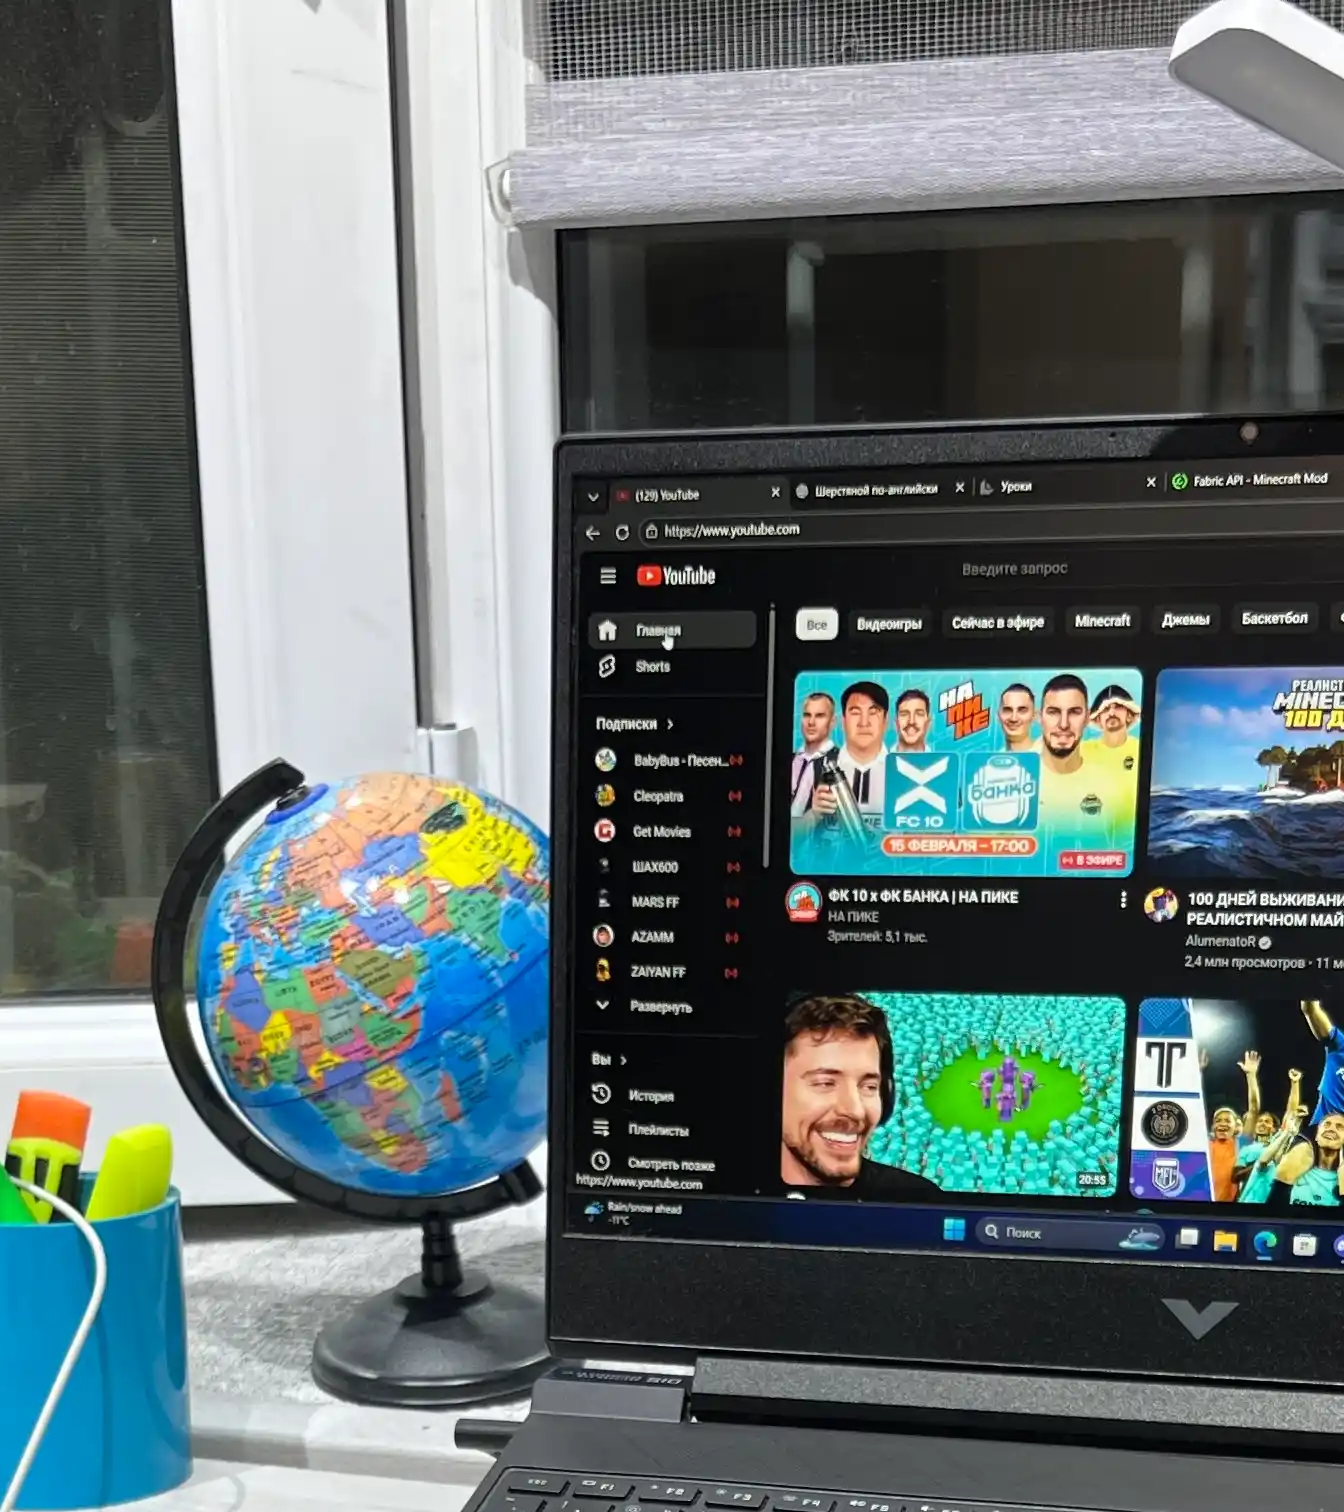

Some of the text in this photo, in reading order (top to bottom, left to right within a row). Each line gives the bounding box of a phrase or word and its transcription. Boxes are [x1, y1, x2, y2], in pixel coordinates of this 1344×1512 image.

[1001, 480, 1032, 494] Уроки
[1194, 472, 1329, 487] Fabric API Minecraft Mod
[635, 488, 700, 503] (129) YouTube
[815, 482, 939, 499] Шерстяной по-английски
[664, 522, 801, 539] https://www.youtube.com
[664, 565, 716, 586] YouTube
[962, 562, 1068, 579] Введите запрос
[806, 619, 828, 631] Все
[857, 617, 923, 633] Видеоигры
[952, 615, 994, 630] Сейчас
[1007, 615, 1045, 632] эфире
[1075, 613, 1132, 628] Minecraft
[1161, 612, 1210, 629] Джемы
[1242, 610, 1308, 626] Баскетбол
[636, 623, 682, 638] Главная
[636, 659, 671, 673] Shorts
[596, 716, 658, 732] Подписки
[1284, 709, 1323, 730] 100
[634, 754, 680, 769] BabyBus
[633, 790, 684, 805] Cleopatra
[633, 825, 691, 838] Get Movies
[908, 839, 978, 853] ФЕВРАЛЯ
[990, 839, 1029, 852] 17:00
[828, 889, 849, 903] ФК
[852, 889, 868, 902] 10
[880, 889, 901, 903] ФК
[903, 889, 949, 903] БАНКА
[958, 890, 978, 904] НА
[981, 890, 1019, 904] ПИКЕ
[1188, 891, 1214, 906] 100
[1216, 889, 1257, 908] ДНЕЙ
[1186, 912, 1308, 928] РЕАЛИСТИЧНОМ
[1185, 935, 1256, 949] AlumenatoR
[1184, 955, 1202, 970] 2,4
[1205, 957, 1229, 969] млн
[1232, 957, 1306, 972] просмотров
[1316, 957, 1330, 970] 11
[630, 999, 693, 1015] Развернуть
[591, 1052, 612, 1066] Вы
[628, 1088, 675, 1104] История
[628, 1123, 690, 1138] Плейлисты
[628, 1157, 680, 1172] Смотреть
[576, 1173, 703, 1191] https://www.youtube.com
[1006, 1227, 1041, 1240] Поиск
